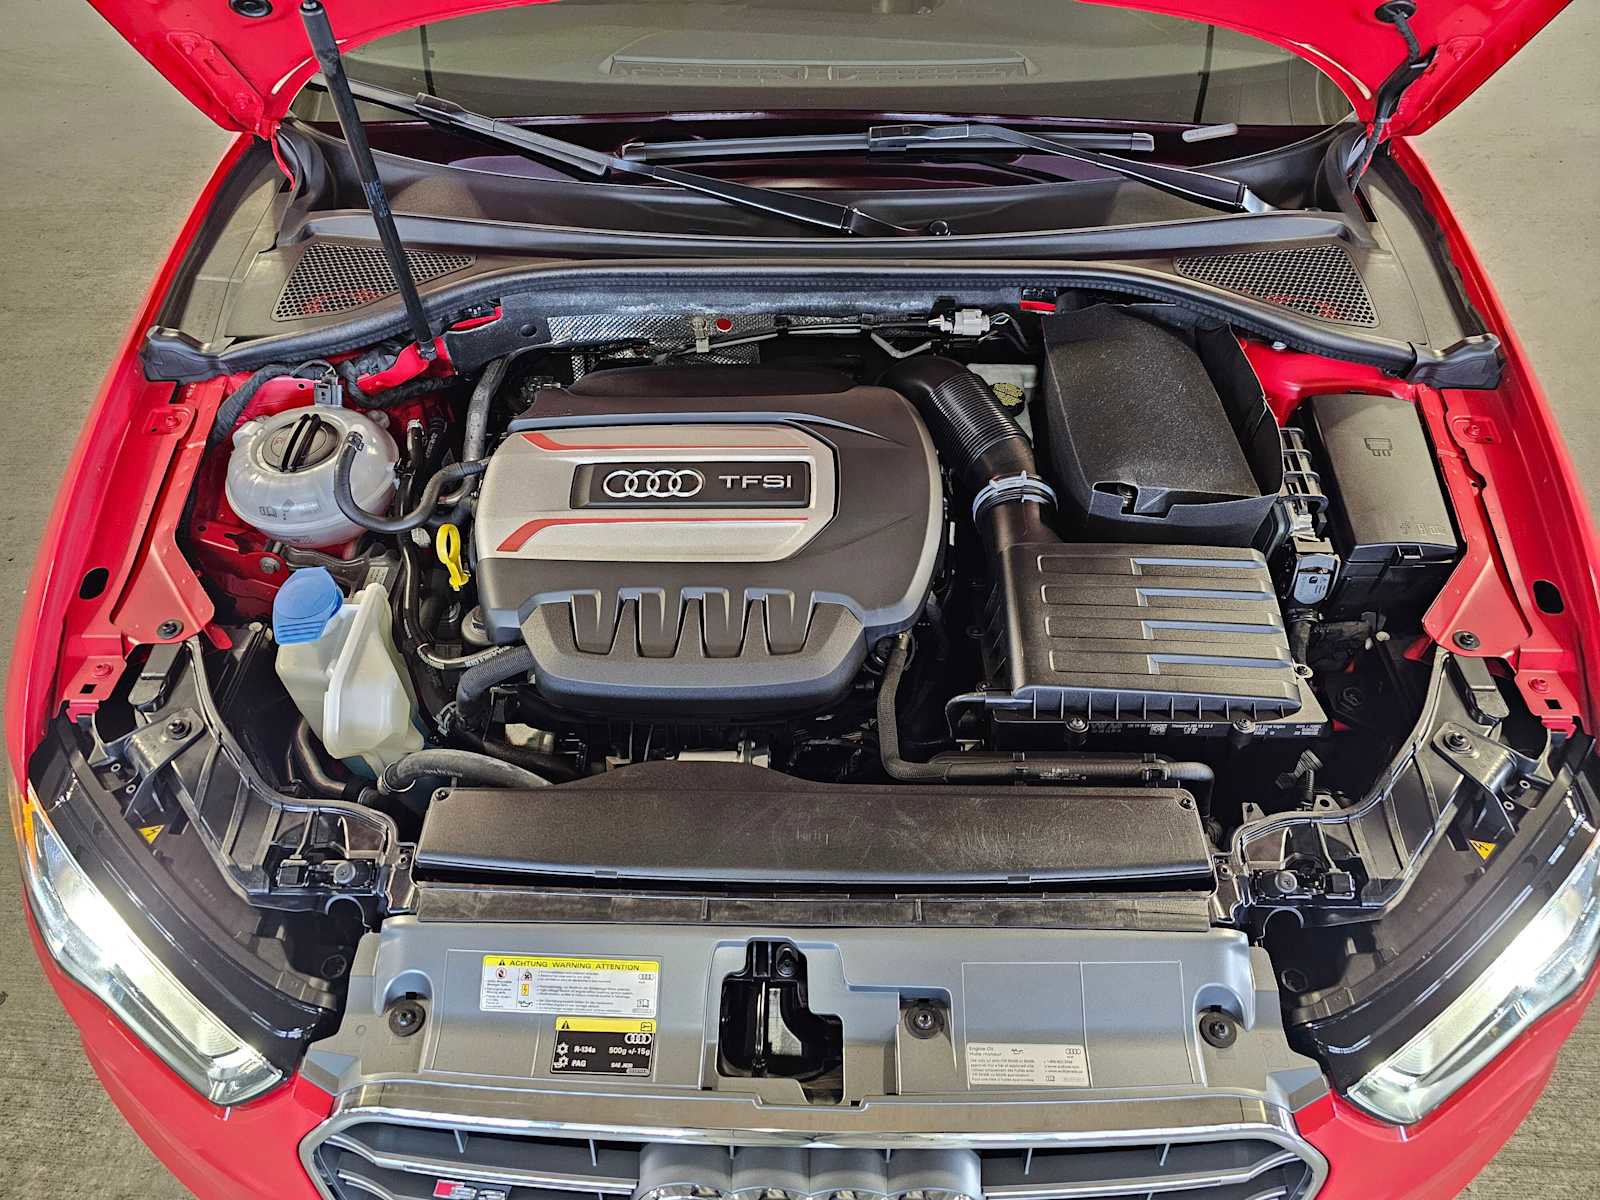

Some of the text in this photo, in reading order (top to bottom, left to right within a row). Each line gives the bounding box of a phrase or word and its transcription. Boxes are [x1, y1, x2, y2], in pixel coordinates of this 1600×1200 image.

[718, 474, 792, 489] TFSI
[508, 960, 640, 971] ACHTUNG WARNING ATTENTION
[573, 1045, 596, 1054] R-134a
[608, 1046, 627, 1055] 500g
[571, 1059, 587, 1067] PAG
